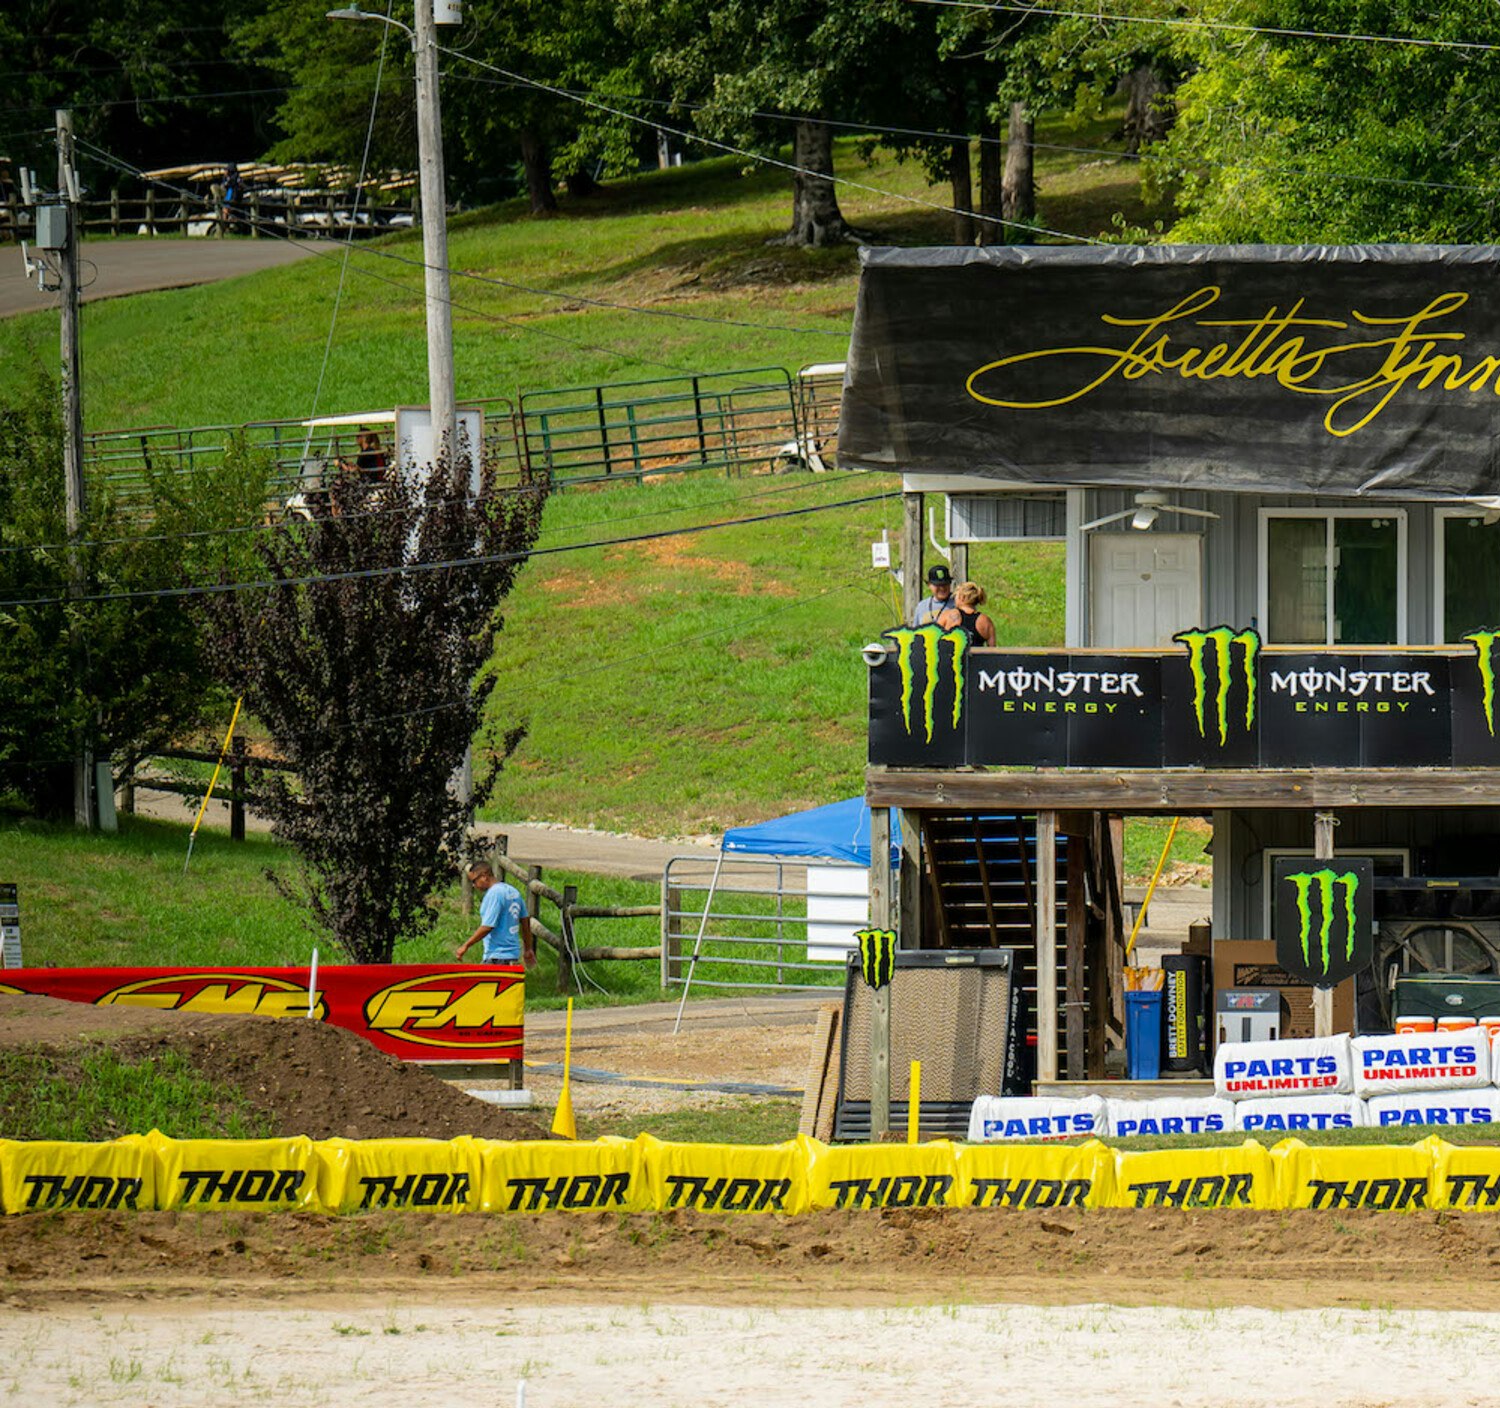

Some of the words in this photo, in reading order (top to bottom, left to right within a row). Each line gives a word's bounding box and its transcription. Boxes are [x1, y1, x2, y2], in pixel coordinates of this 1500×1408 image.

[966, 285, 1349, 409] Loretta
[978, 666, 1144, 697] MONSTER
[1270, 666, 1436, 698] MONSTER
[1003, 701, 1118, 714] ENERGY
[1295, 701, 1411, 713] ENERGY
[1167, 970, 1177, 1022] DOWNEY
[1224, 1055, 1338, 1080] PARTS
[1363, 1046, 1477, 1068] PARTS
[1363, 1065, 1477, 1081] UNLIMITED
[1225, 1075, 1338, 1092] UNLIMITED
[983, 1112, 1096, 1138] PARTS
[1116, 1114, 1225, 1138] PARTS
[1243, 1113, 1354, 1131] PARTS
[1379, 1107, 1493, 1126] PARTS
[24, 1174, 143, 1209] THOR
[177, 1169, 308, 1204] THOR
[358, 1172, 471, 1208] THOR
[505, 1172, 631, 1211] THOR
[664, 1175, 792, 1211] THOR
[828, 1175, 954, 1209] THOR
[970, 1177, 1093, 1209] THOR
[1127, 1173, 1253, 1209] THOR
[1306, 1176, 1429, 1210] THOR
